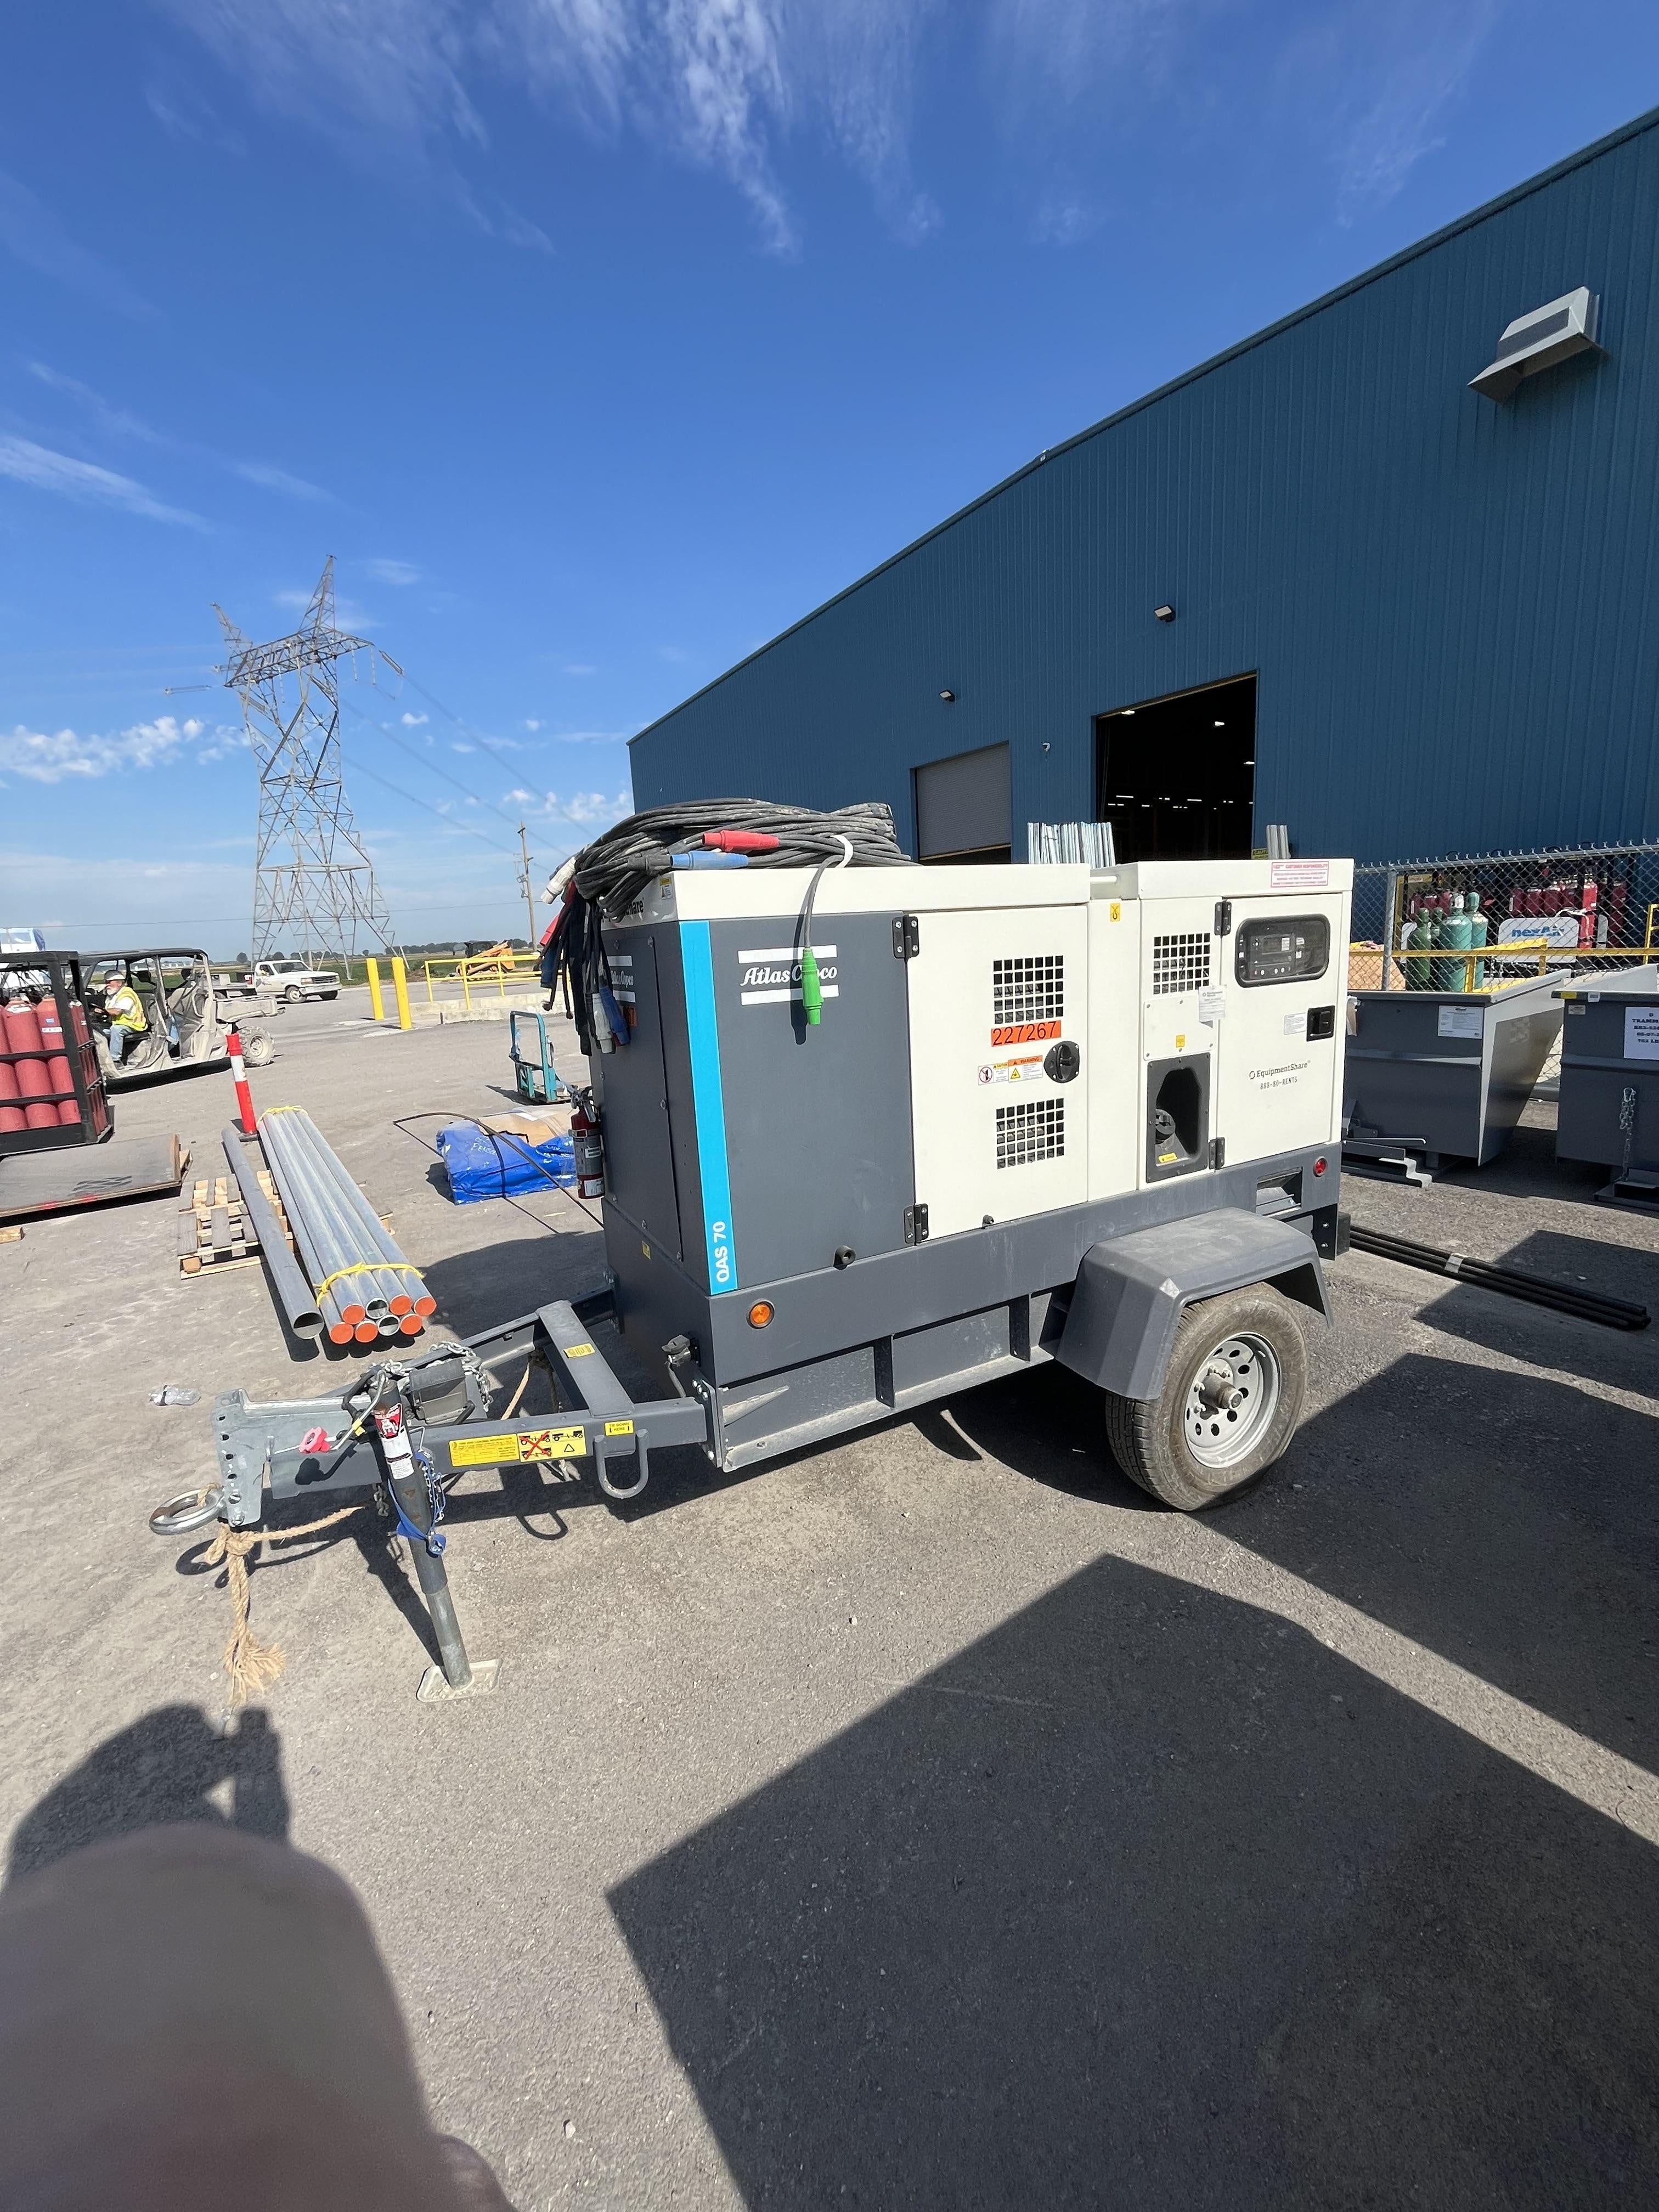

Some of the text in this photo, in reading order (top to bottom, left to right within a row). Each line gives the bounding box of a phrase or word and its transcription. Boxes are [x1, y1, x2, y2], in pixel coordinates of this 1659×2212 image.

[620, 970, 634, 988] Copco
[740, 964, 838, 986] Atlas Cco
[993, 1021, 1057, 1046] 227267
[1257, 1062, 1308, 1078] EquipmentShare
[1260, 1076, 1298, 1090] 888-80-RENTS
[712, 1221, 730, 1283] QAS 70
